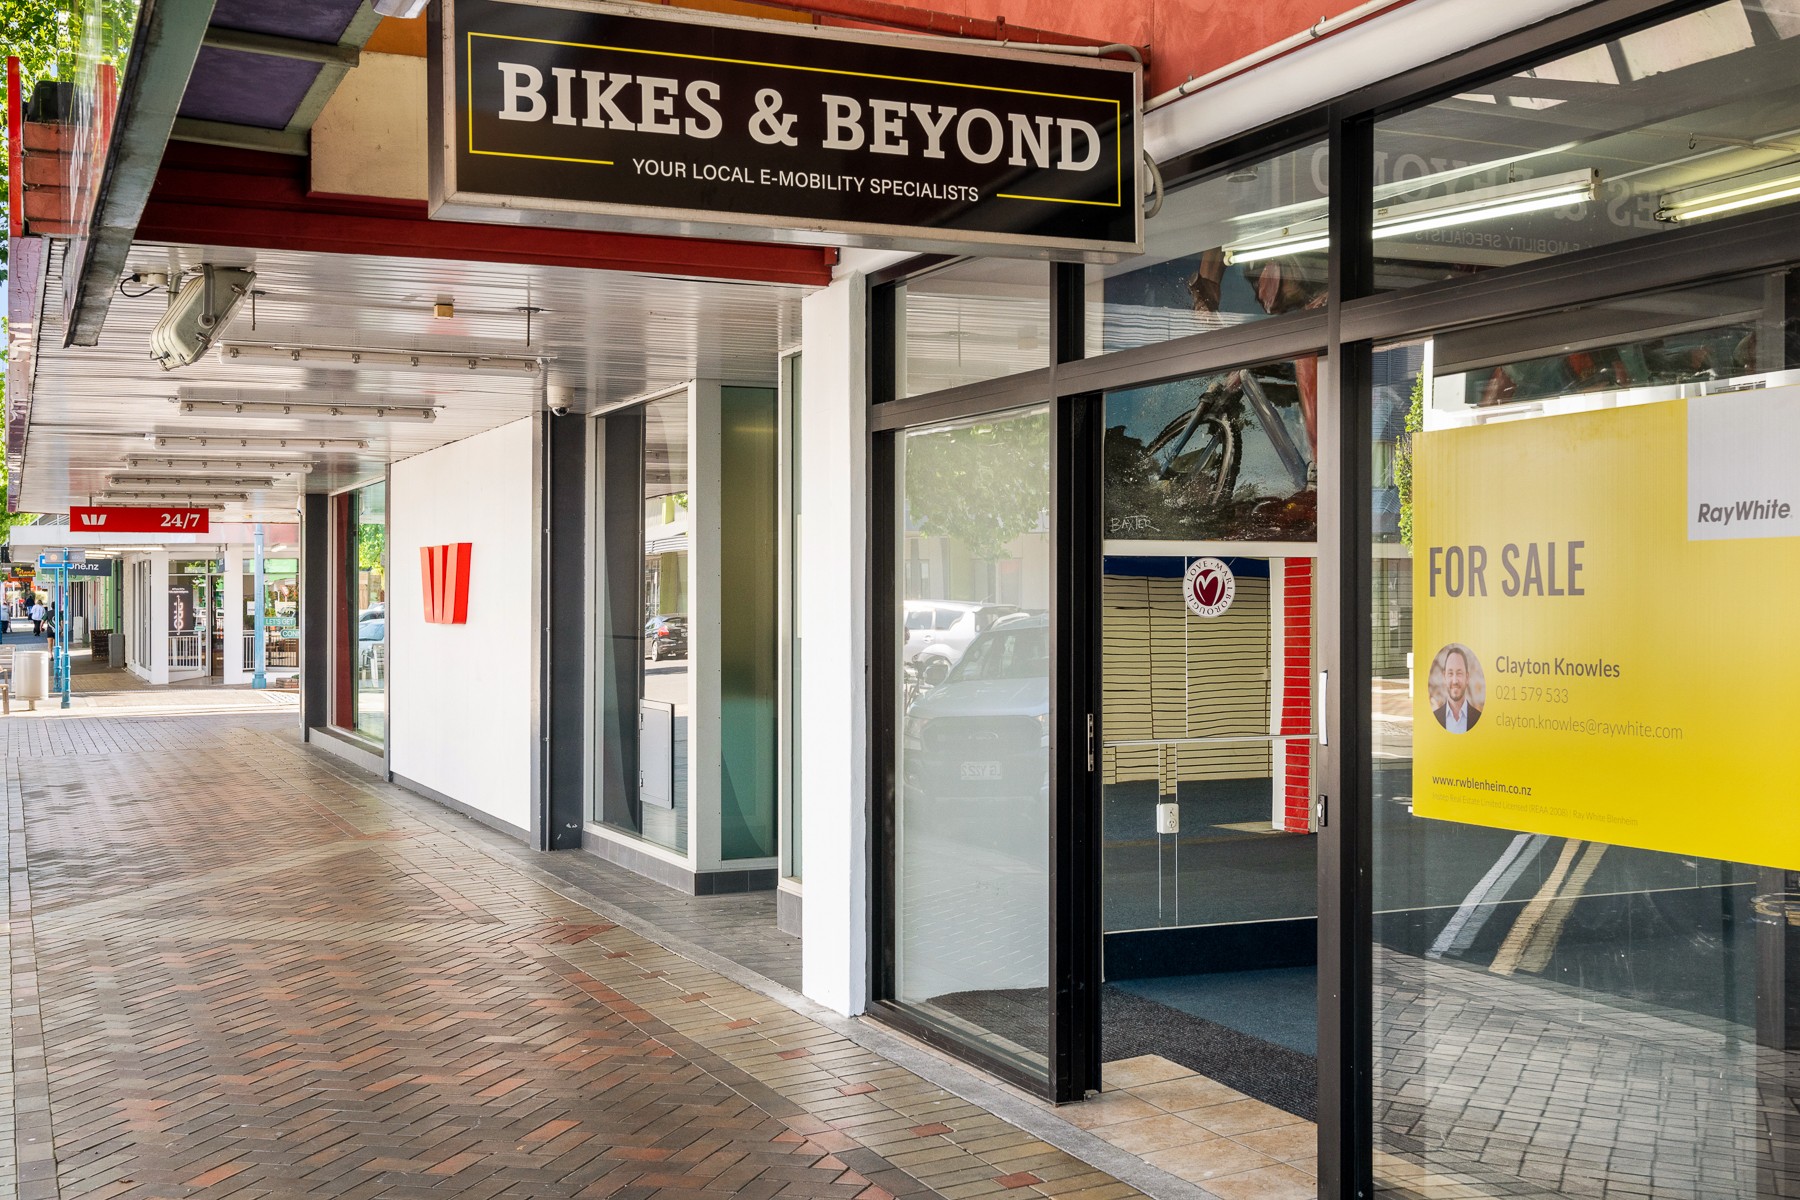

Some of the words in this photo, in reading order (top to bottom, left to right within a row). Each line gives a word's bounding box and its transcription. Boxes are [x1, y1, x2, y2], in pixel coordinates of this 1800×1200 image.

[498, 61, 723, 140] BIKES
[748, 88, 798, 147] &
[822, 93, 1101, 173] BEYOND
[632, 158, 686, 178] YOUR
[693, 163, 755, 184] LOCAL
[760, 169, 865, 192] E-MOBILITY
[870, 178, 979, 202] SPECIALISTS
[160, 513, 201, 529] 24/7
[1110, 515, 1160, 533] BAXTER
[1187, 561, 1208, 582] LOVE
[1429, 545, 1488, 598] FOR
[1501, 540, 1586, 598] SALE
[1187, 563, 1233, 615] MARLBOROUGH
[1496, 656, 1550, 678] Clayton
[1554, 658, 1620, 678] Knowles
[1496, 685, 1517, 701] 021
[1520, 686, 1543, 702] 579
[1545, 688, 1569, 704] 533
[1496, 713, 1683, 740] clayton.knowles@raywhite.com
[1432, 776, 1532, 796] www.rwblenheim.co.nz
[1462, 795, 1480, 806] Estate
[1481, 798, 1502, 809] Limited
[1502, 800, 1528, 813] Licensed
[1529, 804, 1549, 815] (REAA
[1550, 806, 1569, 818] 2008)
[1573, 809, 1585, 821] Ray
[1586, 811, 1606, 823] White
[1607, 813, 1639, 827] Blenheim
